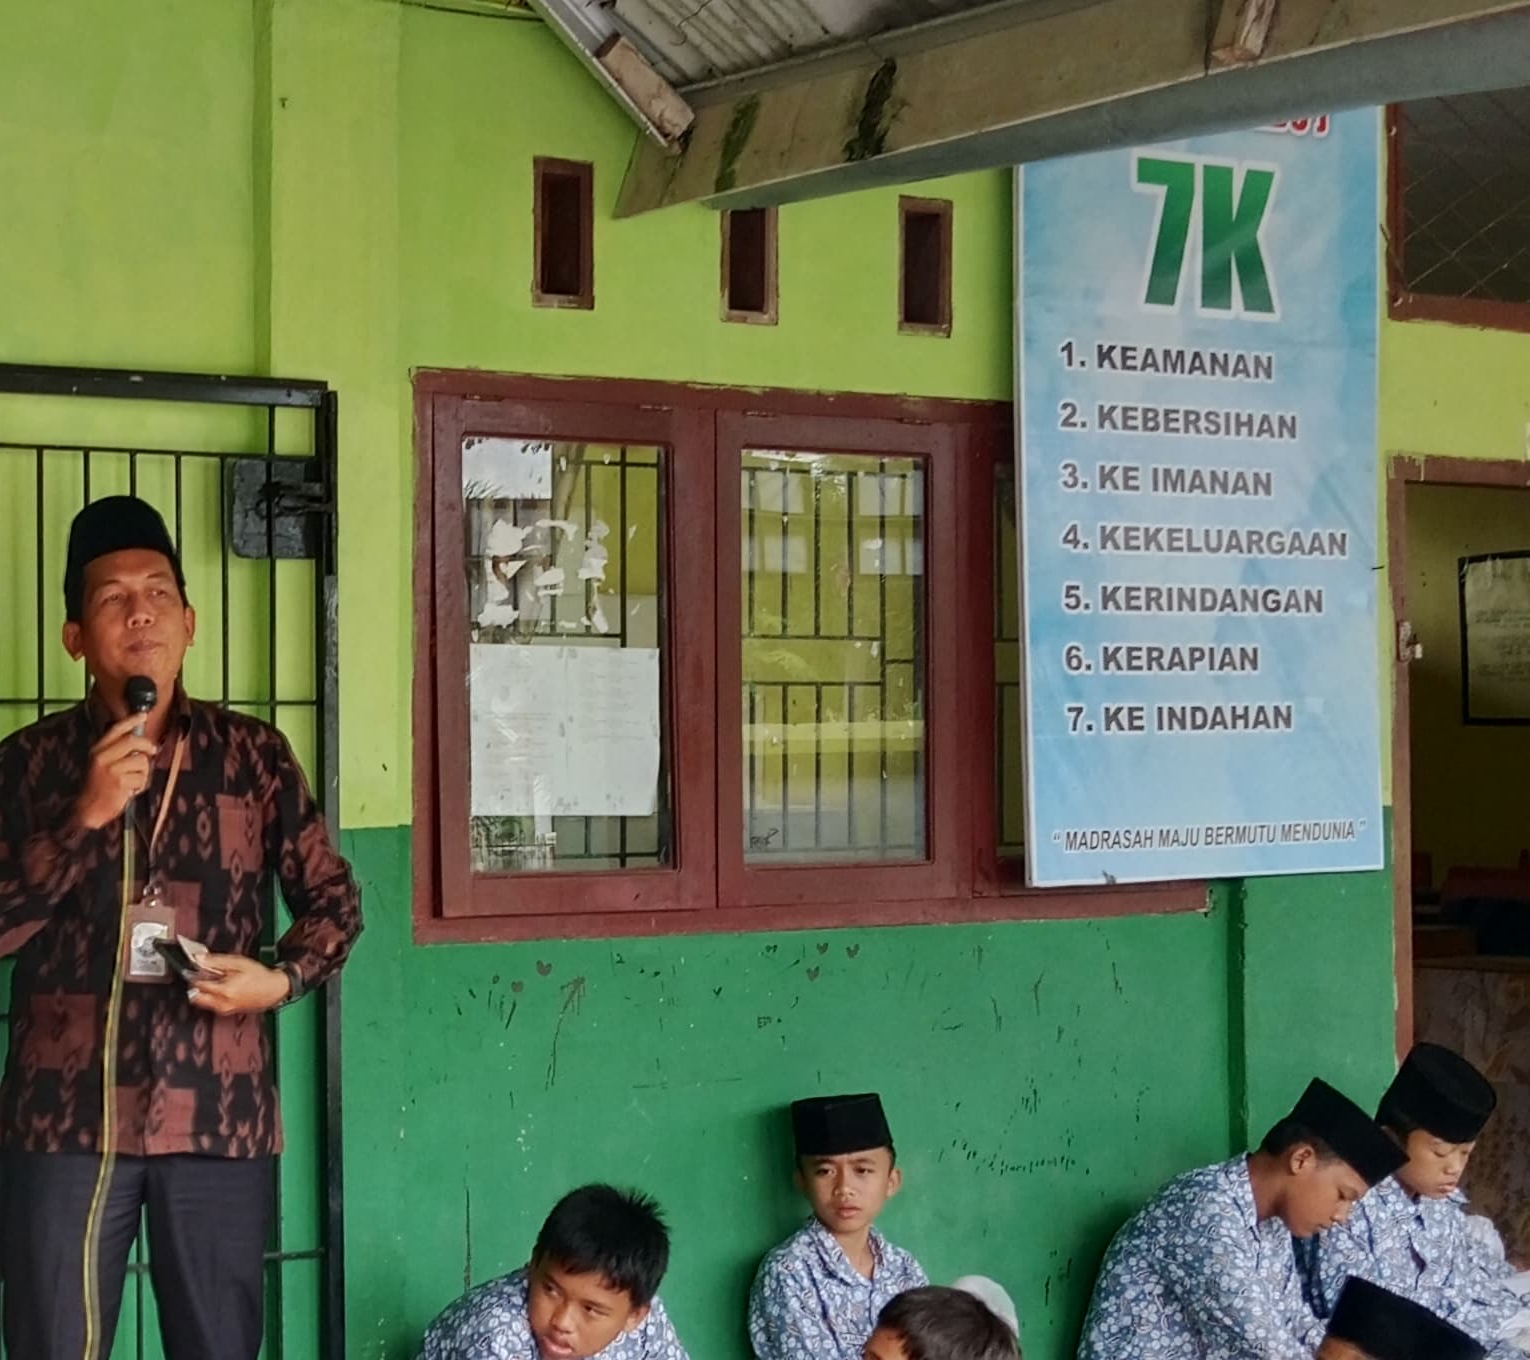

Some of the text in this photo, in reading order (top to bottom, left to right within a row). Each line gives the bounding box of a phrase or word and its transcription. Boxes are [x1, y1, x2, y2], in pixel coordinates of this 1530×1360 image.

[1136, 156, 1276, 314] 7K
[1060, 342, 1274, 381] 1. KEAMANAN
[1059, 401, 1298, 440] 2. KEBERSIHAN
[1061, 463, 1089, 490] 3.
[1062, 523, 1347, 557] 4. KEKELUARGAAN
[1063, 584, 1324, 614] 5. KERINDANGAN
[1064, 644, 1260, 673] 6. KERAPIAN
[1065, 706, 1094, 733] 7.
[1064, 820, 1357, 852] MADRASAH MAJU BERMUTU MENDUNIA
